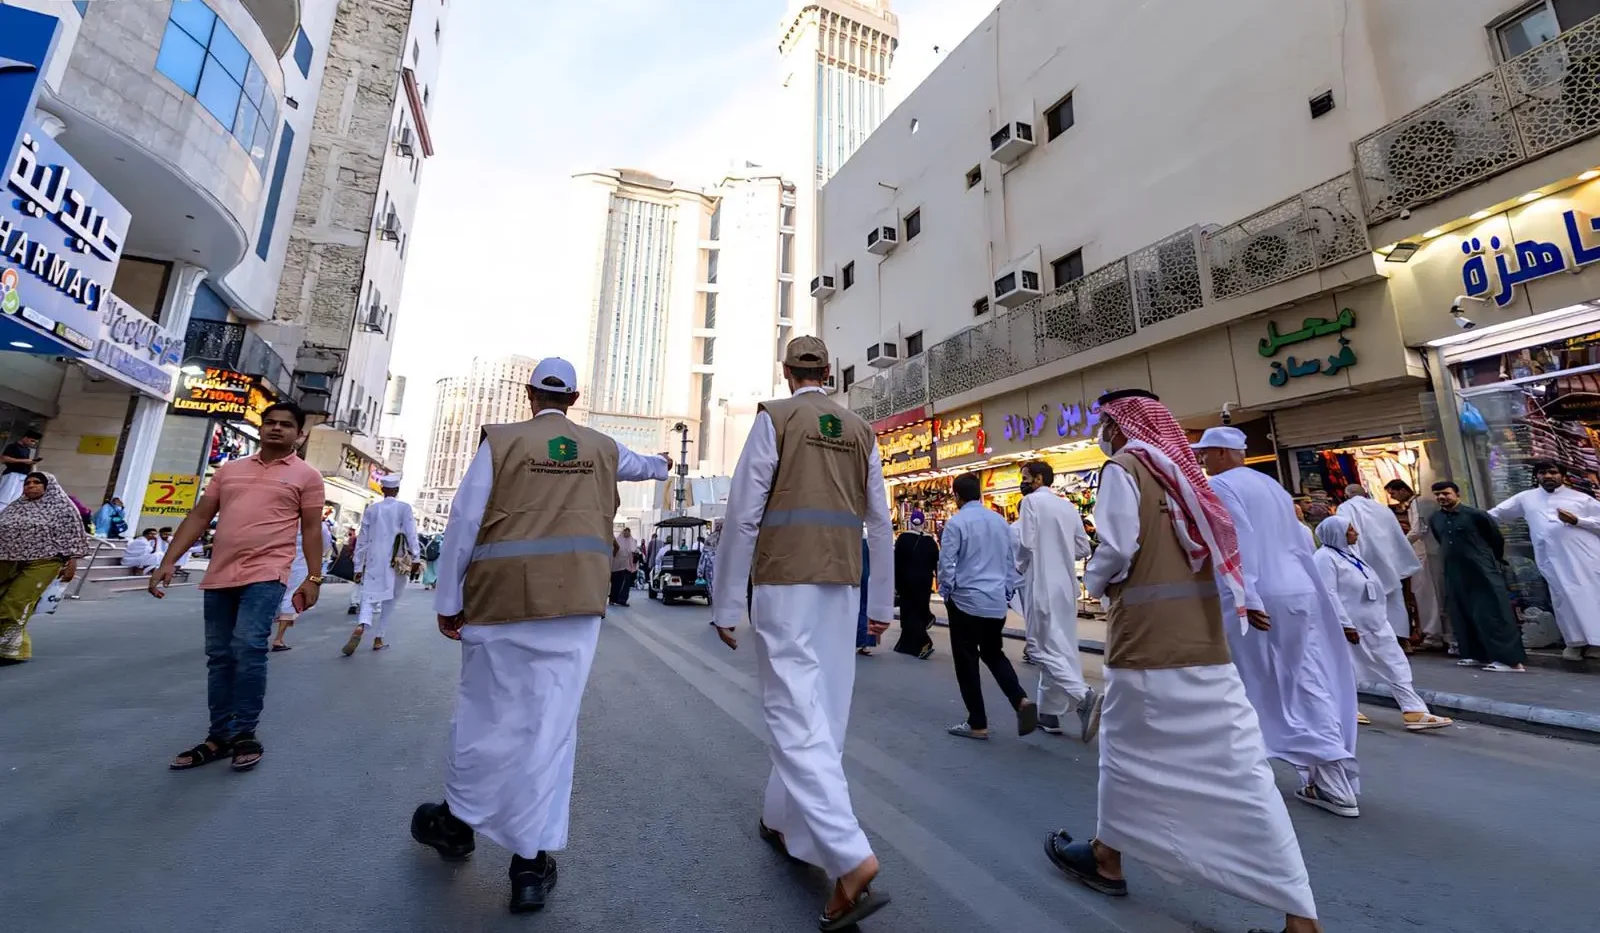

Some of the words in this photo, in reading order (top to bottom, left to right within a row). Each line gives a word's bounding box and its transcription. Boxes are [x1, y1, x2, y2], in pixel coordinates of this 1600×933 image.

[9, 132, 121, 262] صيدلية
[1461, 209, 1600, 307] اهزة
[155, 484, 176, 504] 2
